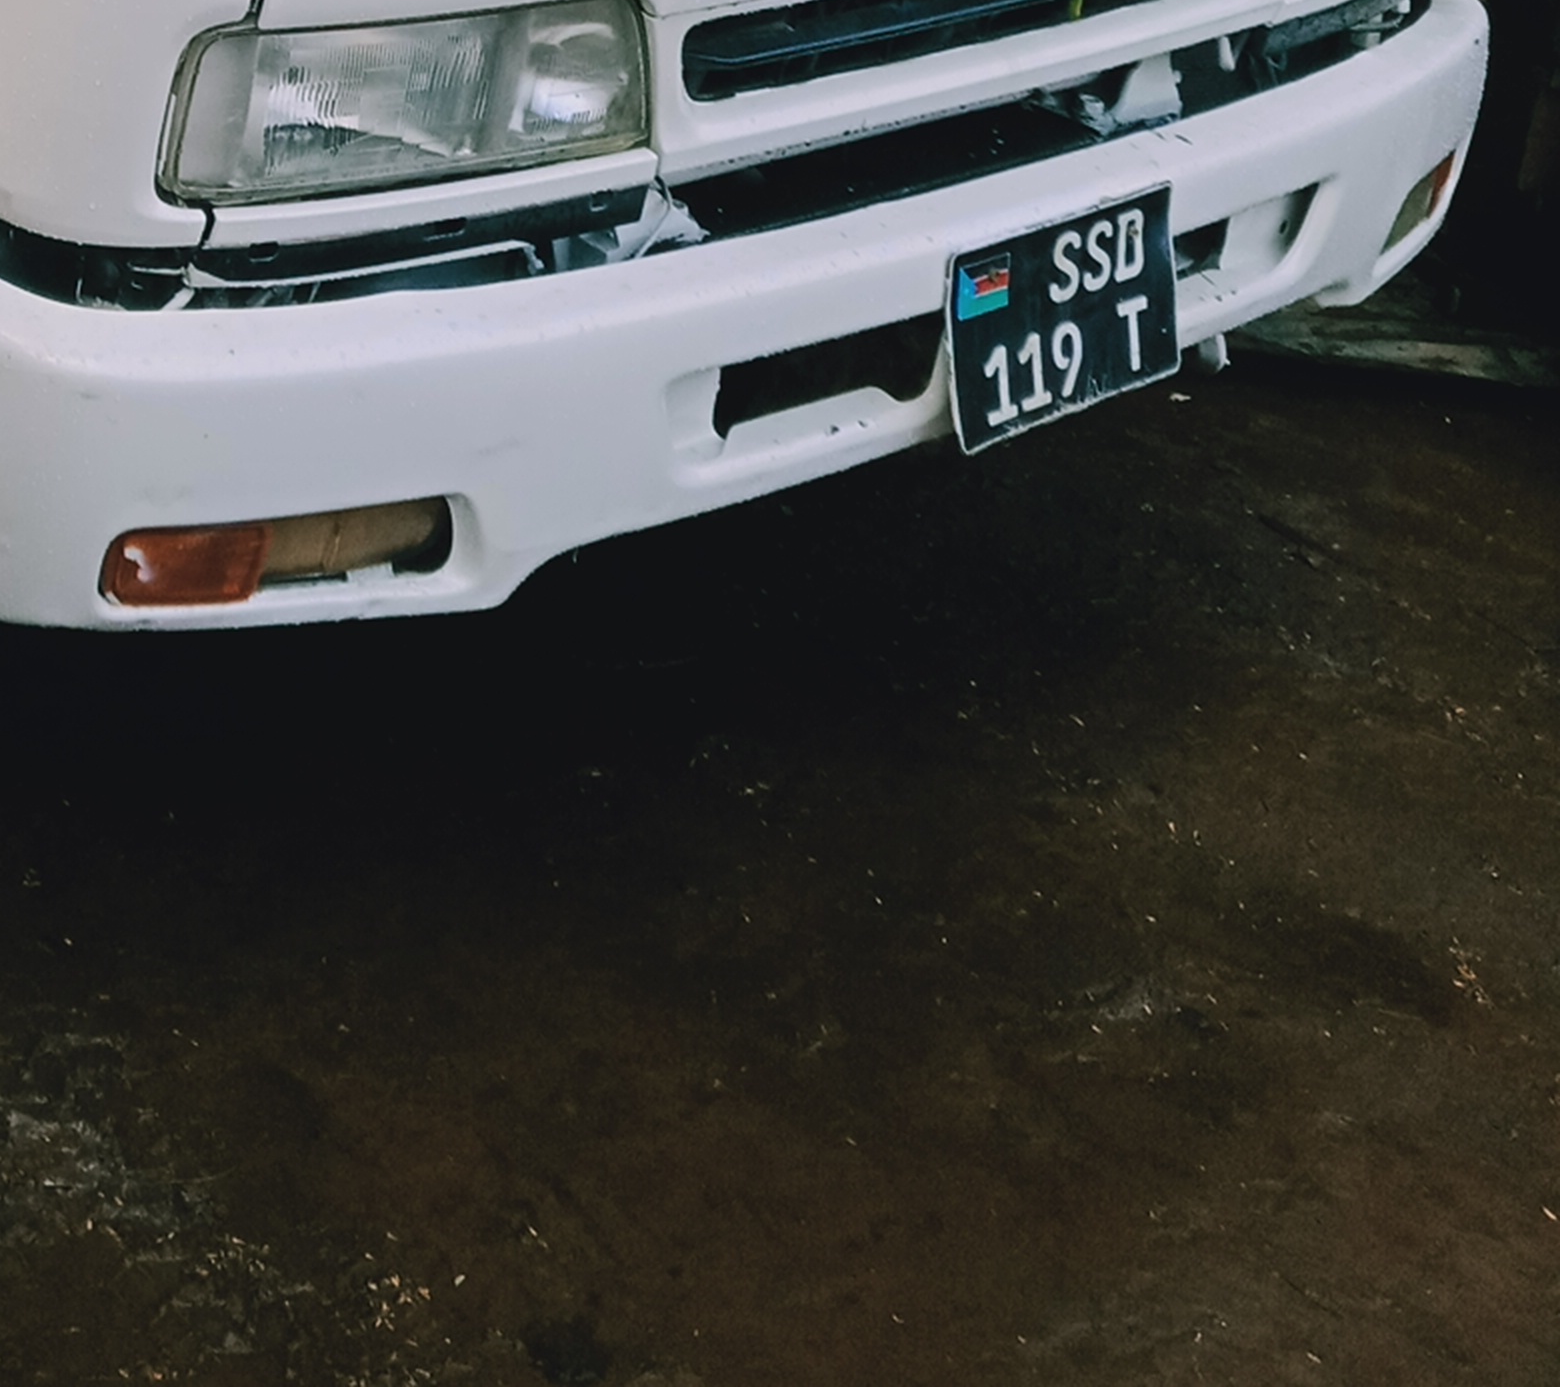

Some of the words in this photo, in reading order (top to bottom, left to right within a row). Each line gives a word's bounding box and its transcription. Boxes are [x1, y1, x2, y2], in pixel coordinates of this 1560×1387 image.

[1048, 207, 1146, 305] SSD
[983, 320, 1085, 428] 119
[1116, 294, 1149, 373] T
